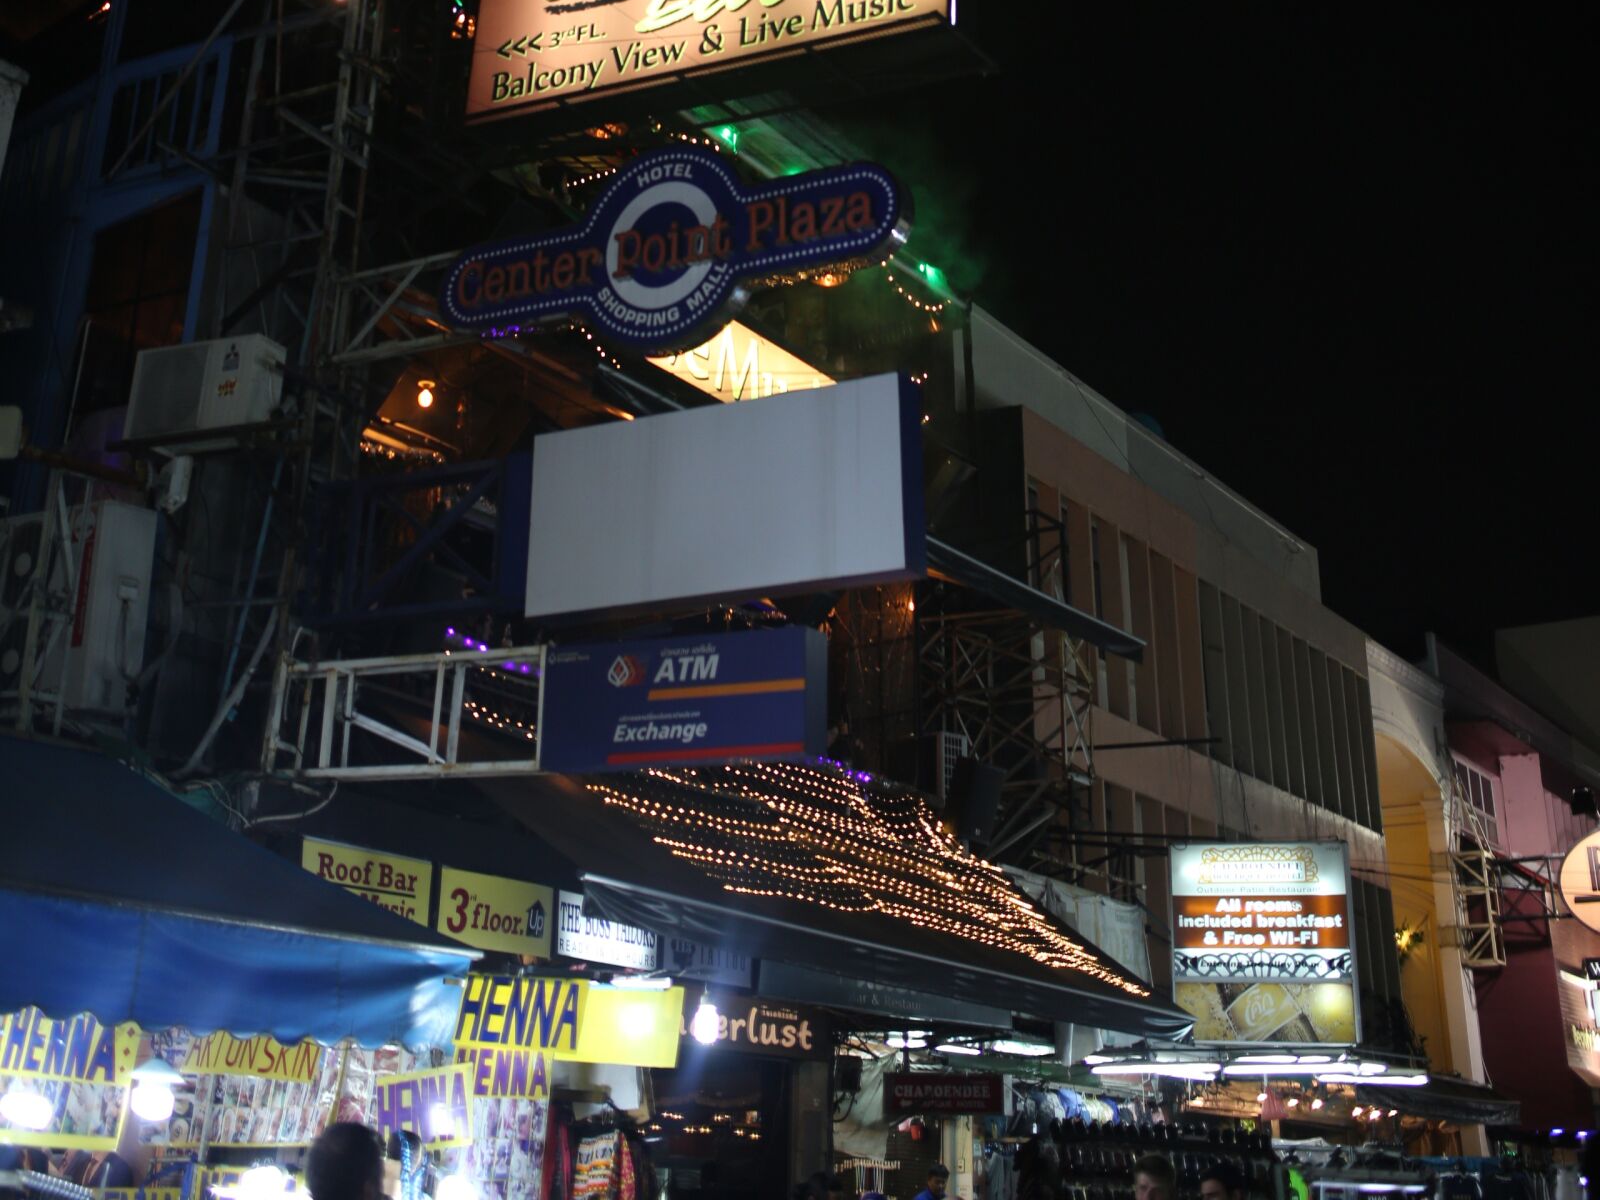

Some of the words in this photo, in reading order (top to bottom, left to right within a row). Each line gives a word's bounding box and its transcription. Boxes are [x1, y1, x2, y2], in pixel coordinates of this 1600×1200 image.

[490, 58, 606, 103] Balcony
[611, 39, 690, 75] View
[699, 23, 726, 57] &
[739, 10, 805, 48] Live
[636, 163, 695, 188] HOTEL
[457, 246, 604, 308] Center
[612, 212, 734, 281] Point
[745, 190, 877, 251] Plaza
[598, 289, 681, 328] SHOPPING
[685, 262, 729, 309] MALL
[653, 653, 720, 684] ATM
[612, 720, 708, 744] Exchange
[316, 852, 374, 887] Roof
[377, 861, 418, 893] Bar
[471, 902, 524, 935] floor.
[529, 906, 544, 934] Up
[560, 902, 581, 934] THE
[1178, 914, 1252, 928] included
[1255, 914, 1343, 928] breakfast
[1215, 897, 1242, 913] All
[1245, 899, 1303, 913] rooms
[1203, 930, 1219, 945] &
[1223, 930, 1265, 945] Free
[455, 974, 580, 1050] HENNA
[1, 1005, 116, 1083] HENNA
